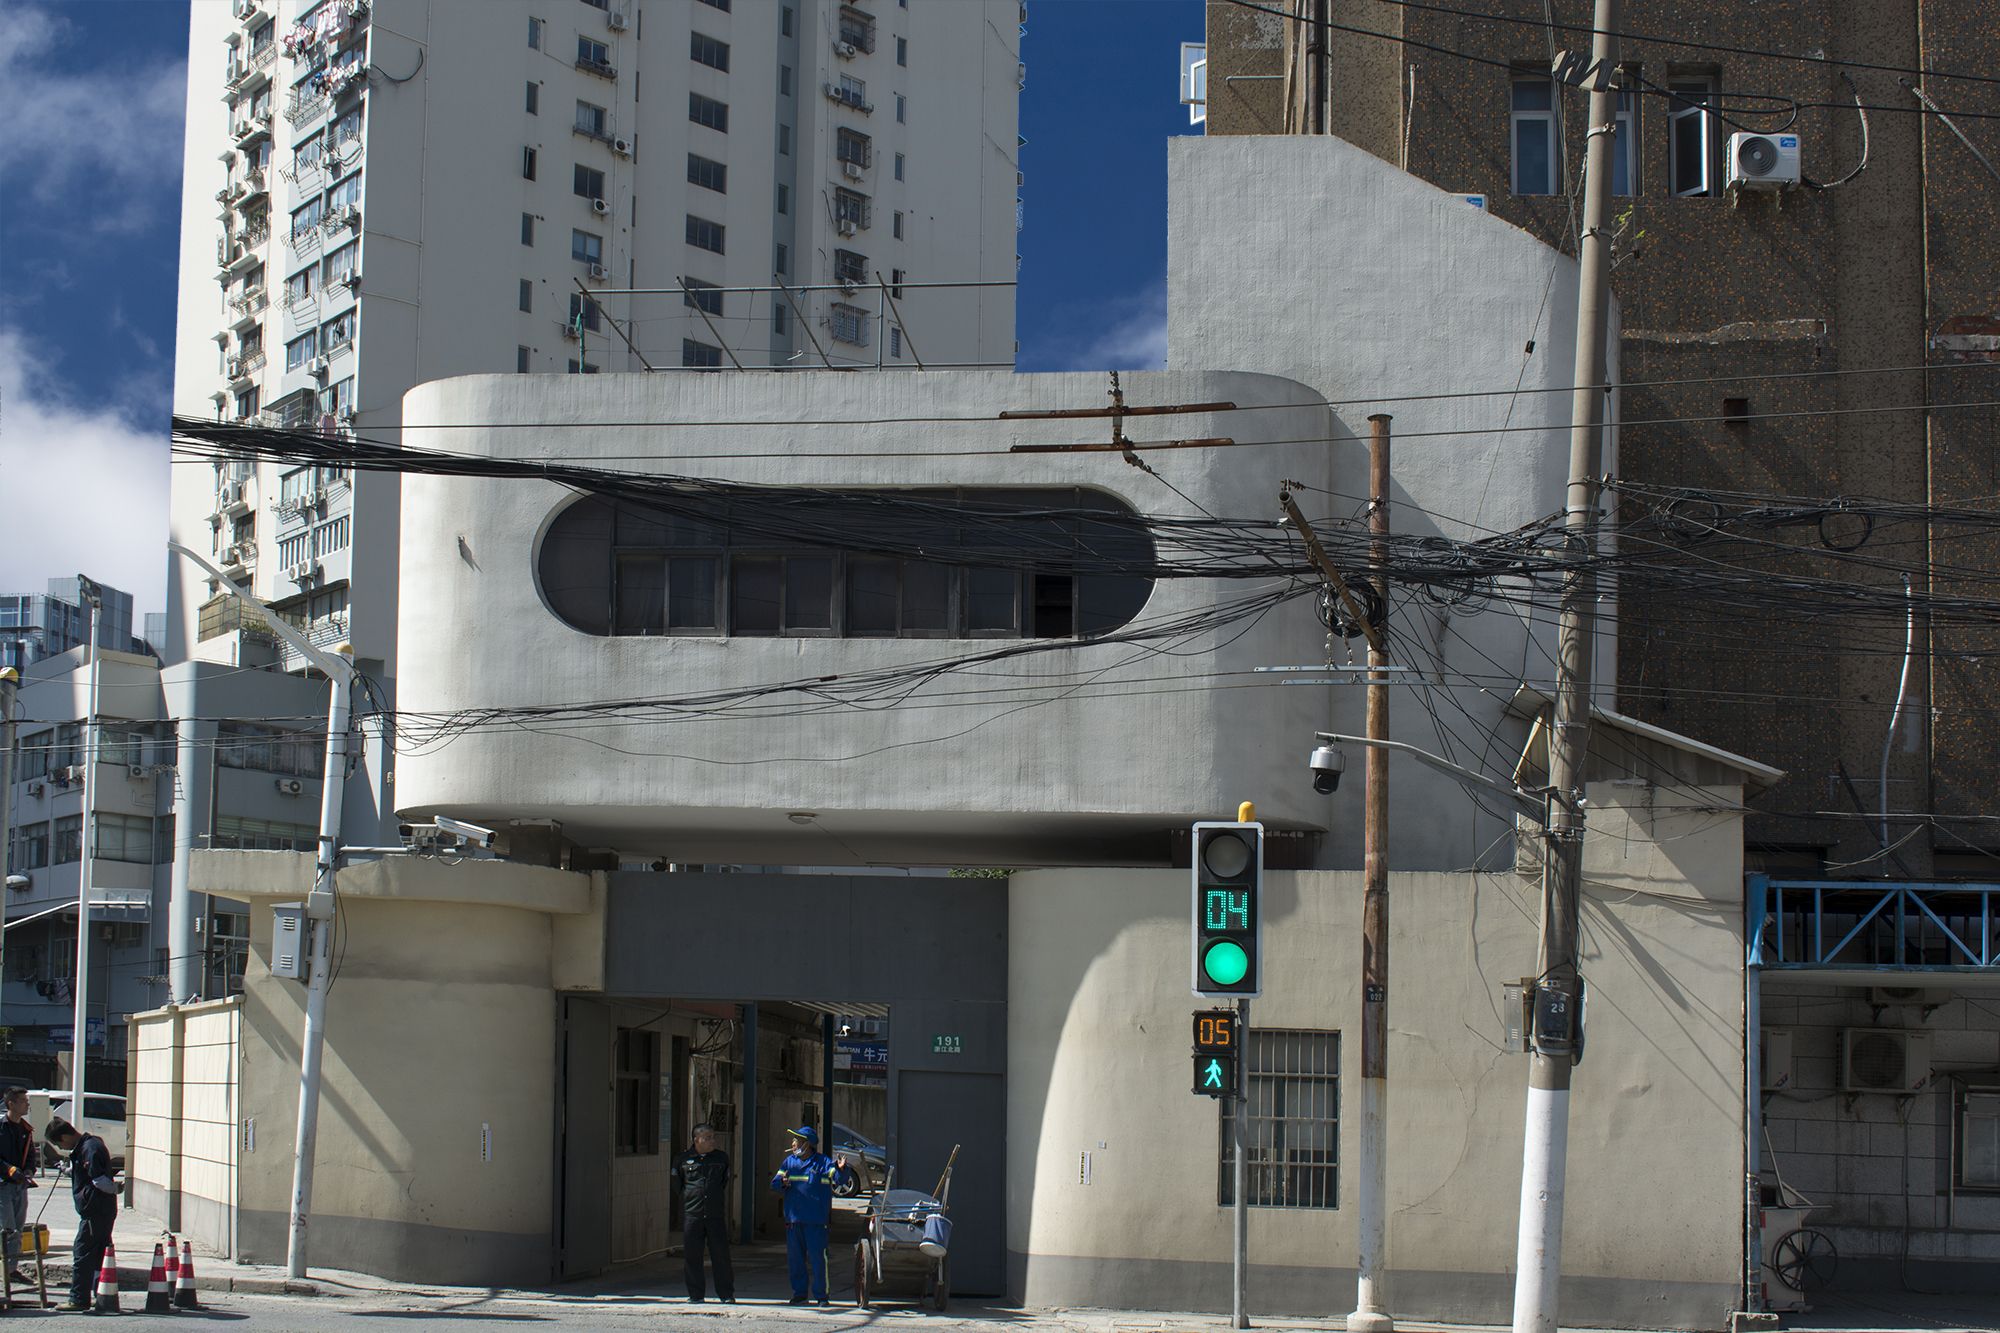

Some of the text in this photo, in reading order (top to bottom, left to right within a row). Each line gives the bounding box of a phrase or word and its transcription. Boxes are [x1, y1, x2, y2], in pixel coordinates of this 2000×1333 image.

[1207, 890, 1248, 929] 04
[936, 1036, 960, 1046] 191
[1199, 1018, 1231, 1045] 05
